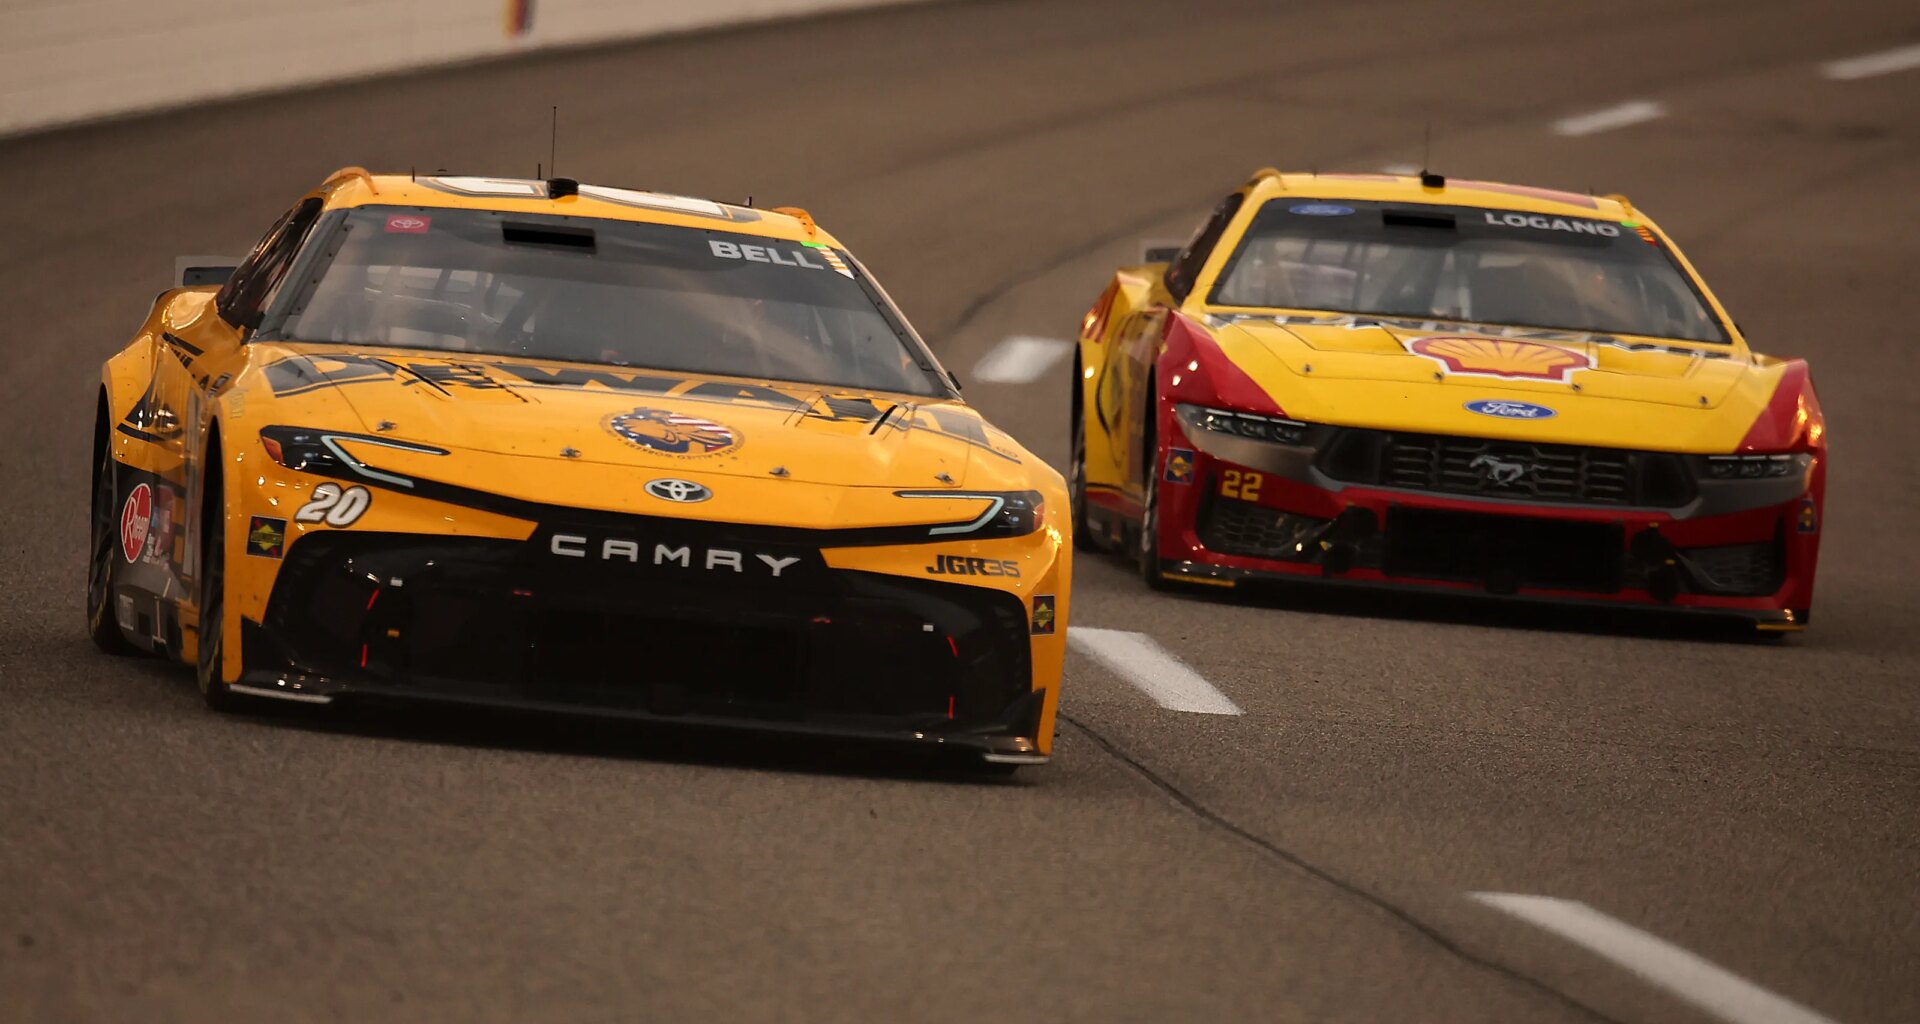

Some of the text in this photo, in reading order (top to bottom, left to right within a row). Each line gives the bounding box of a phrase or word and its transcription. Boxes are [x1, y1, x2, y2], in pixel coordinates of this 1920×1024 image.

[1484, 212, 1620, 238] LOGANO
[708, 239, 825, 271] BELL
[1481, 401, 1539, 418] Ford
[1220, 469, 1263, 502] 22
[294, 482, 372, 528] 20
[550, 533, 801, 578] CAMRY
[926, 555, 1021, 579] JGR35
